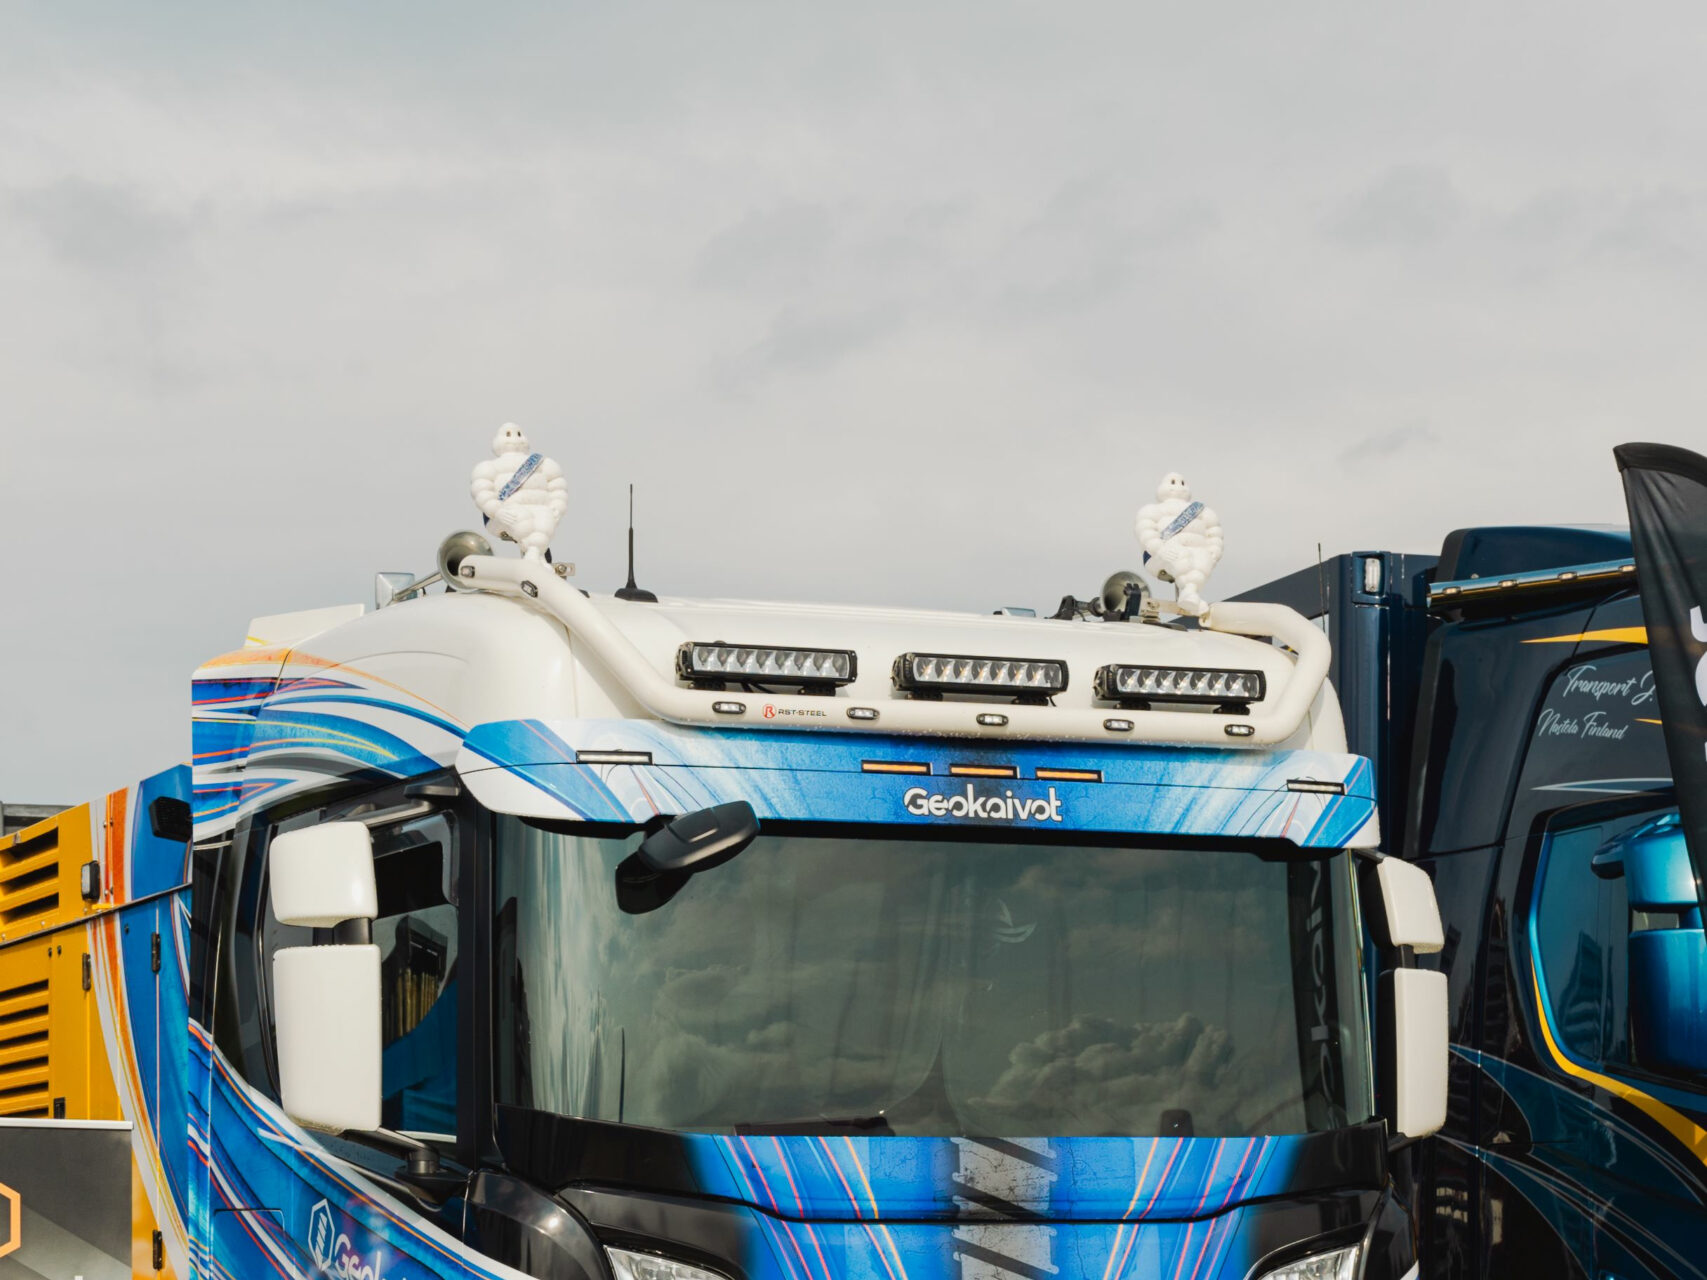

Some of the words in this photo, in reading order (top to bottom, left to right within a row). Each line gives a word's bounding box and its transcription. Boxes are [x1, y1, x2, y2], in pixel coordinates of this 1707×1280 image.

[1562, 664, 1637, 701] Transport
[778, 708, 827, 717] RST-STEEL
[1581, 711, 1630, 740] Finland
[903, 783, 1063, 823] Geokaivot
